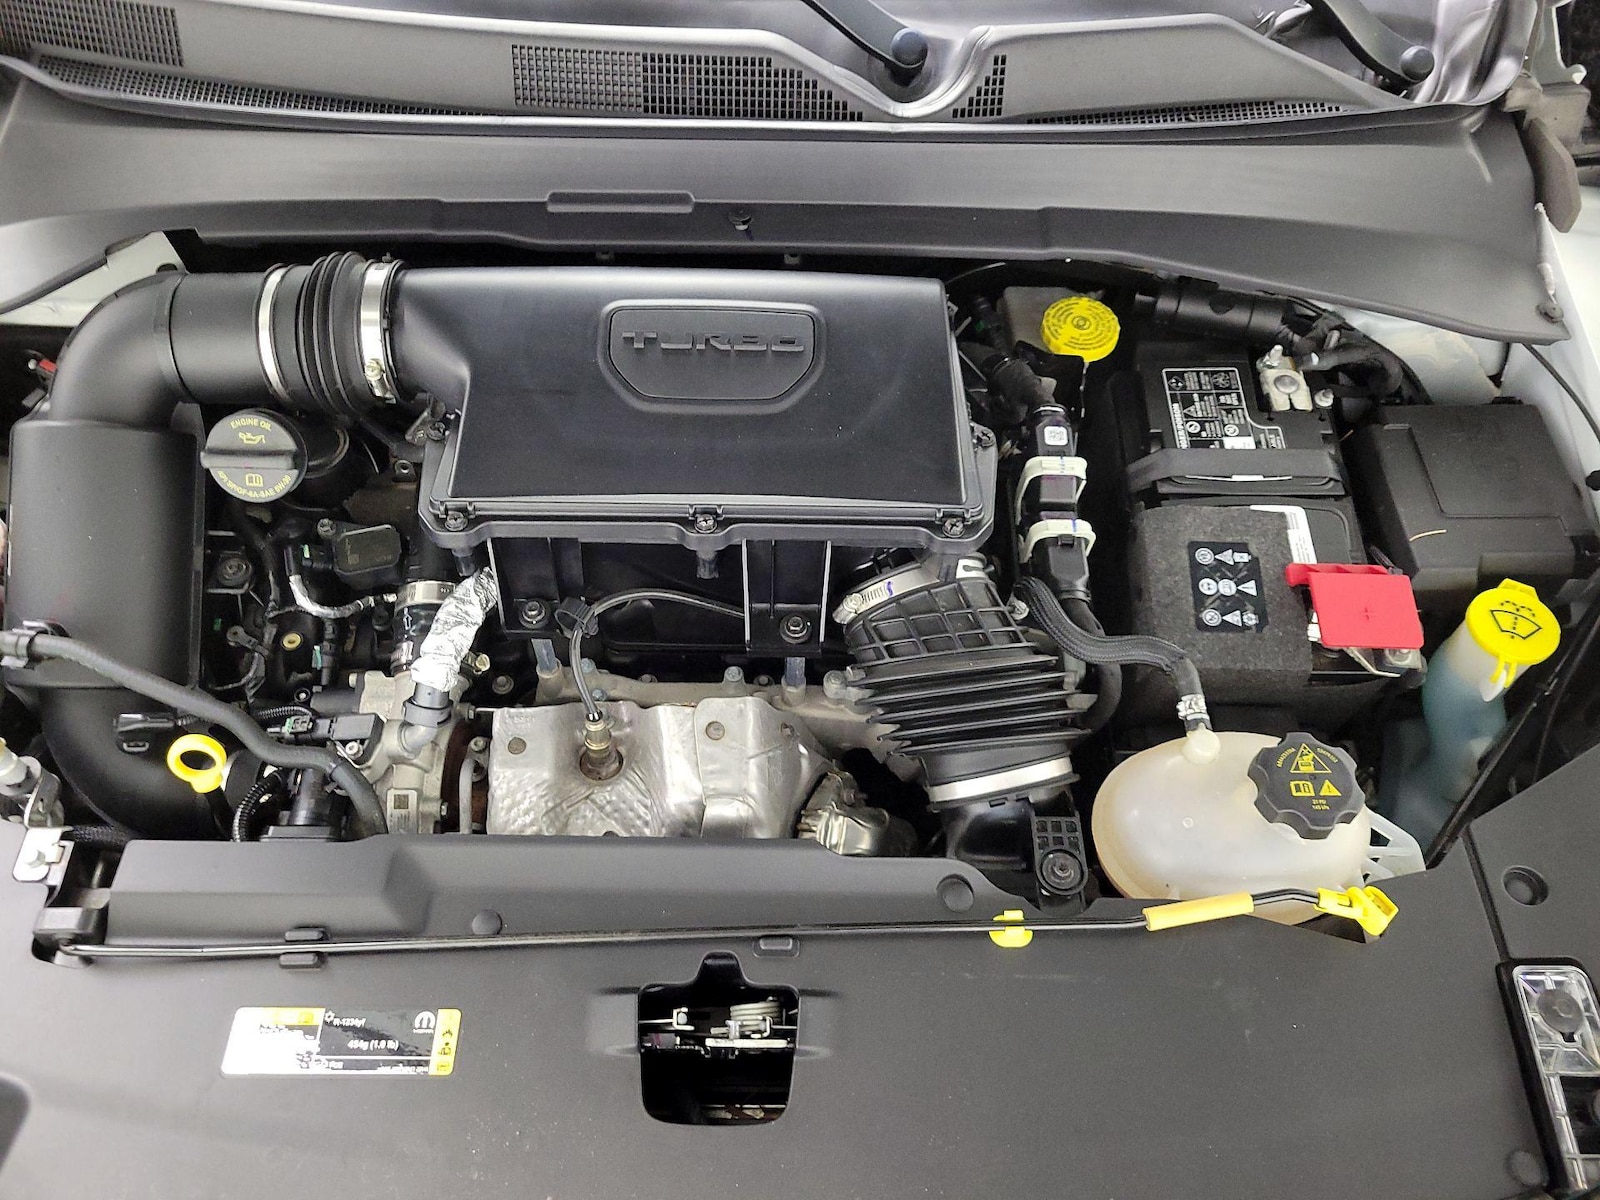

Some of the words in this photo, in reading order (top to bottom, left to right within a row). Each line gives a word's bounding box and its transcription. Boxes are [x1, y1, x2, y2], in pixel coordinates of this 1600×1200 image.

[621, 331, 805, 352] TURBO
[230, 417, 259, 429] ENGINE
[260, 420, 272, 432] OIL
